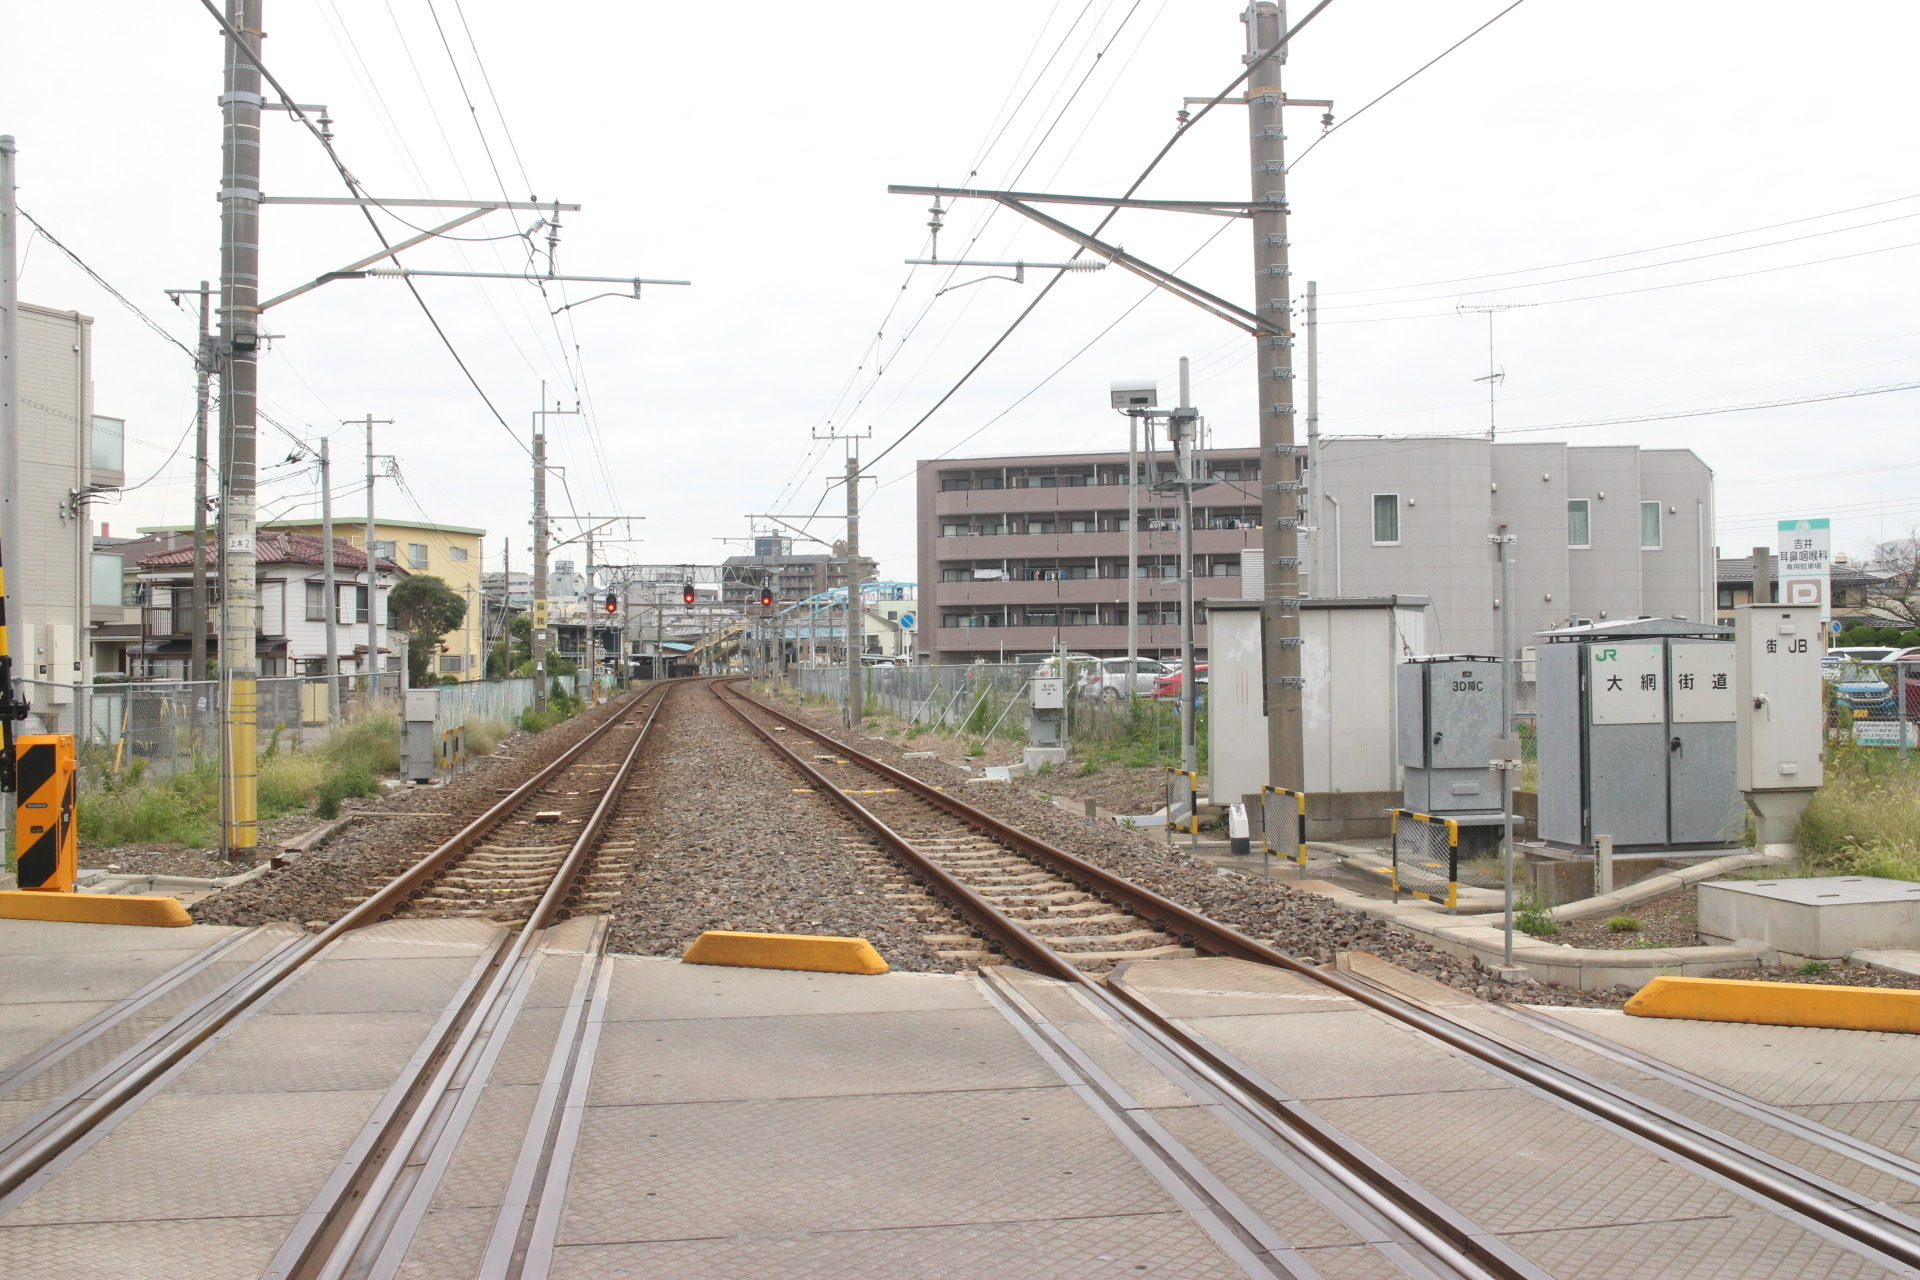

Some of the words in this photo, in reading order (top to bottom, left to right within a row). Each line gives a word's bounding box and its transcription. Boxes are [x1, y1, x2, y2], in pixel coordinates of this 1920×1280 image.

[1794, 538, 1813, 550] 吉井
[1780, 550, 1828, 562] 耳鼻咽喉科
[1786, 562, 1822, 571] 専用駐車場
[1792, 584, 1818, 603] P
[535, 602, 546, 626] 蘇我
[1788, 639, 1808, 653] JB
[1595, 649, 1617, 662] JR
[1607, 673, 1727, 691] 大網街道
